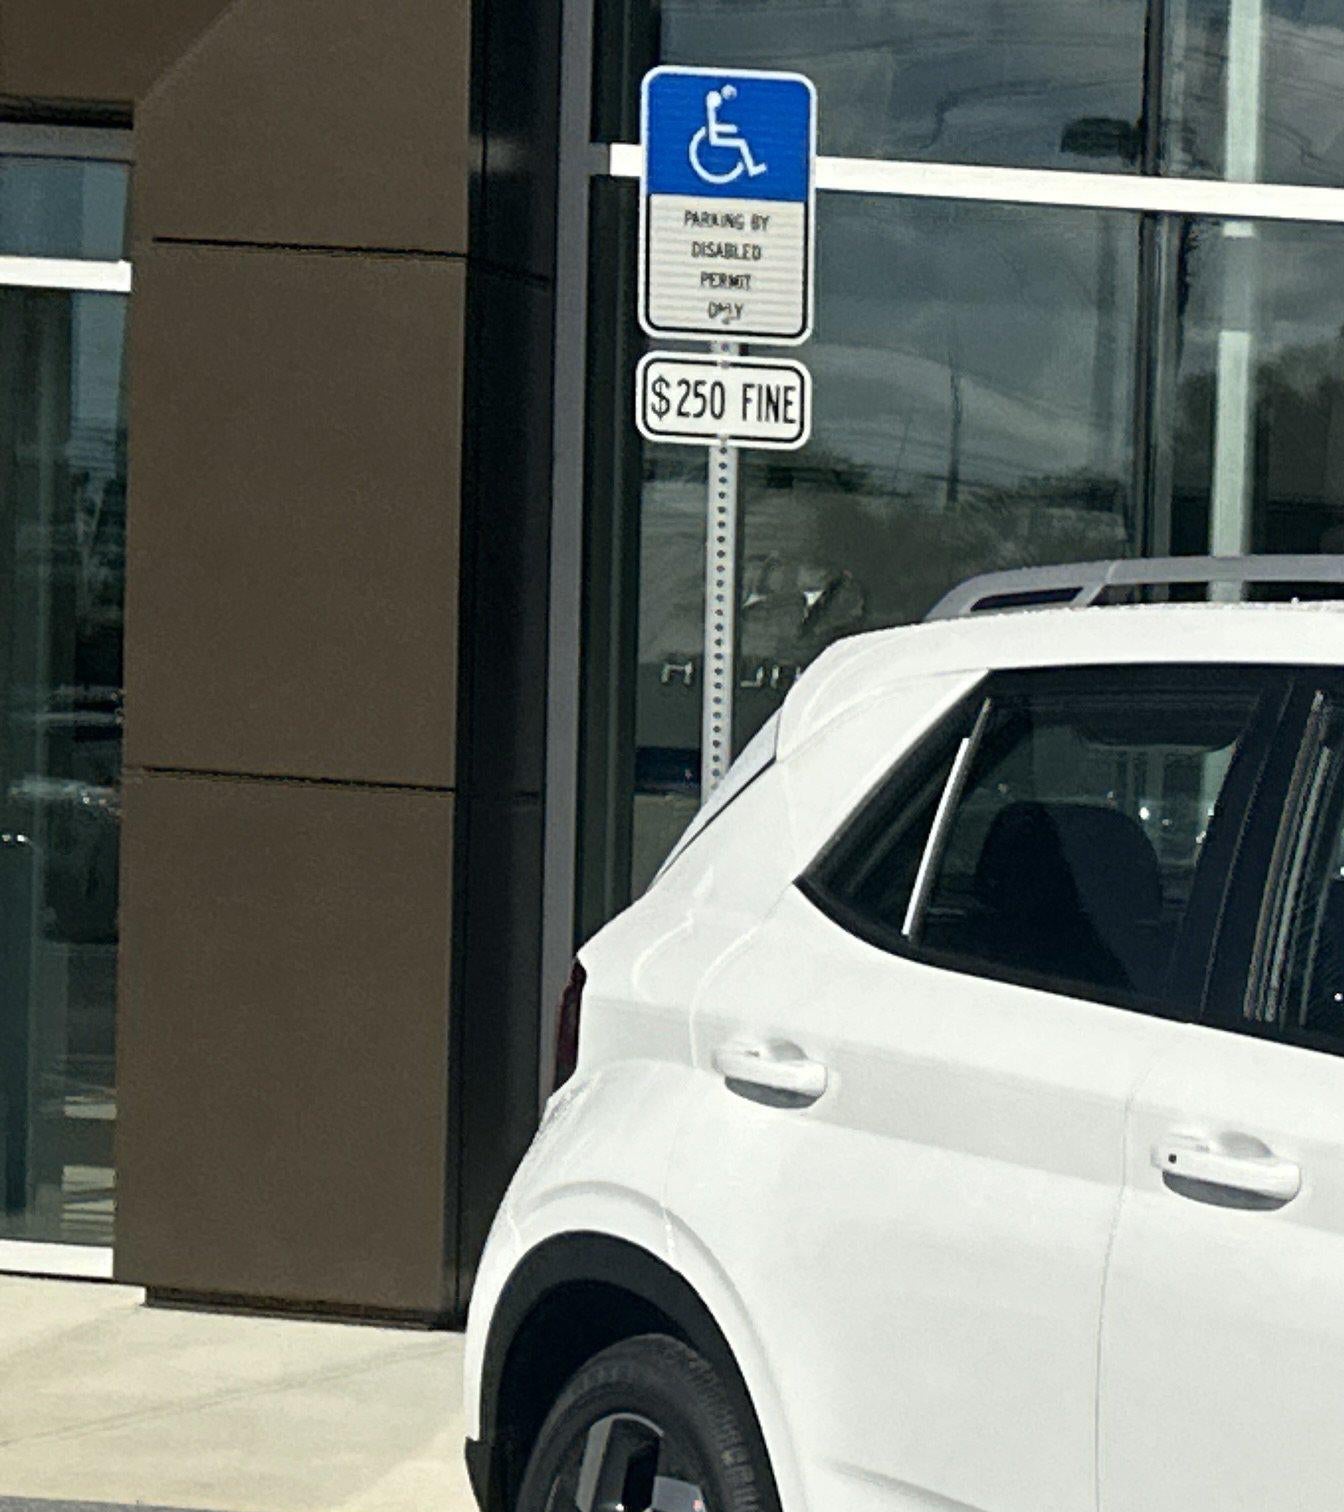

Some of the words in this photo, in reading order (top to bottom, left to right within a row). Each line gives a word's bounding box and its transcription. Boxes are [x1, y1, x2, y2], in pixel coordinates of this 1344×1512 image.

[684, 209, 745, 231] PARKING
[750, 213, 770, 231] BY
[691, 240, 762, 261] DISABLED
[700, 270, 751, 290] PERMIT
[651, 375, 726, 422] $250
[742, 383, 797, 424] FINE
